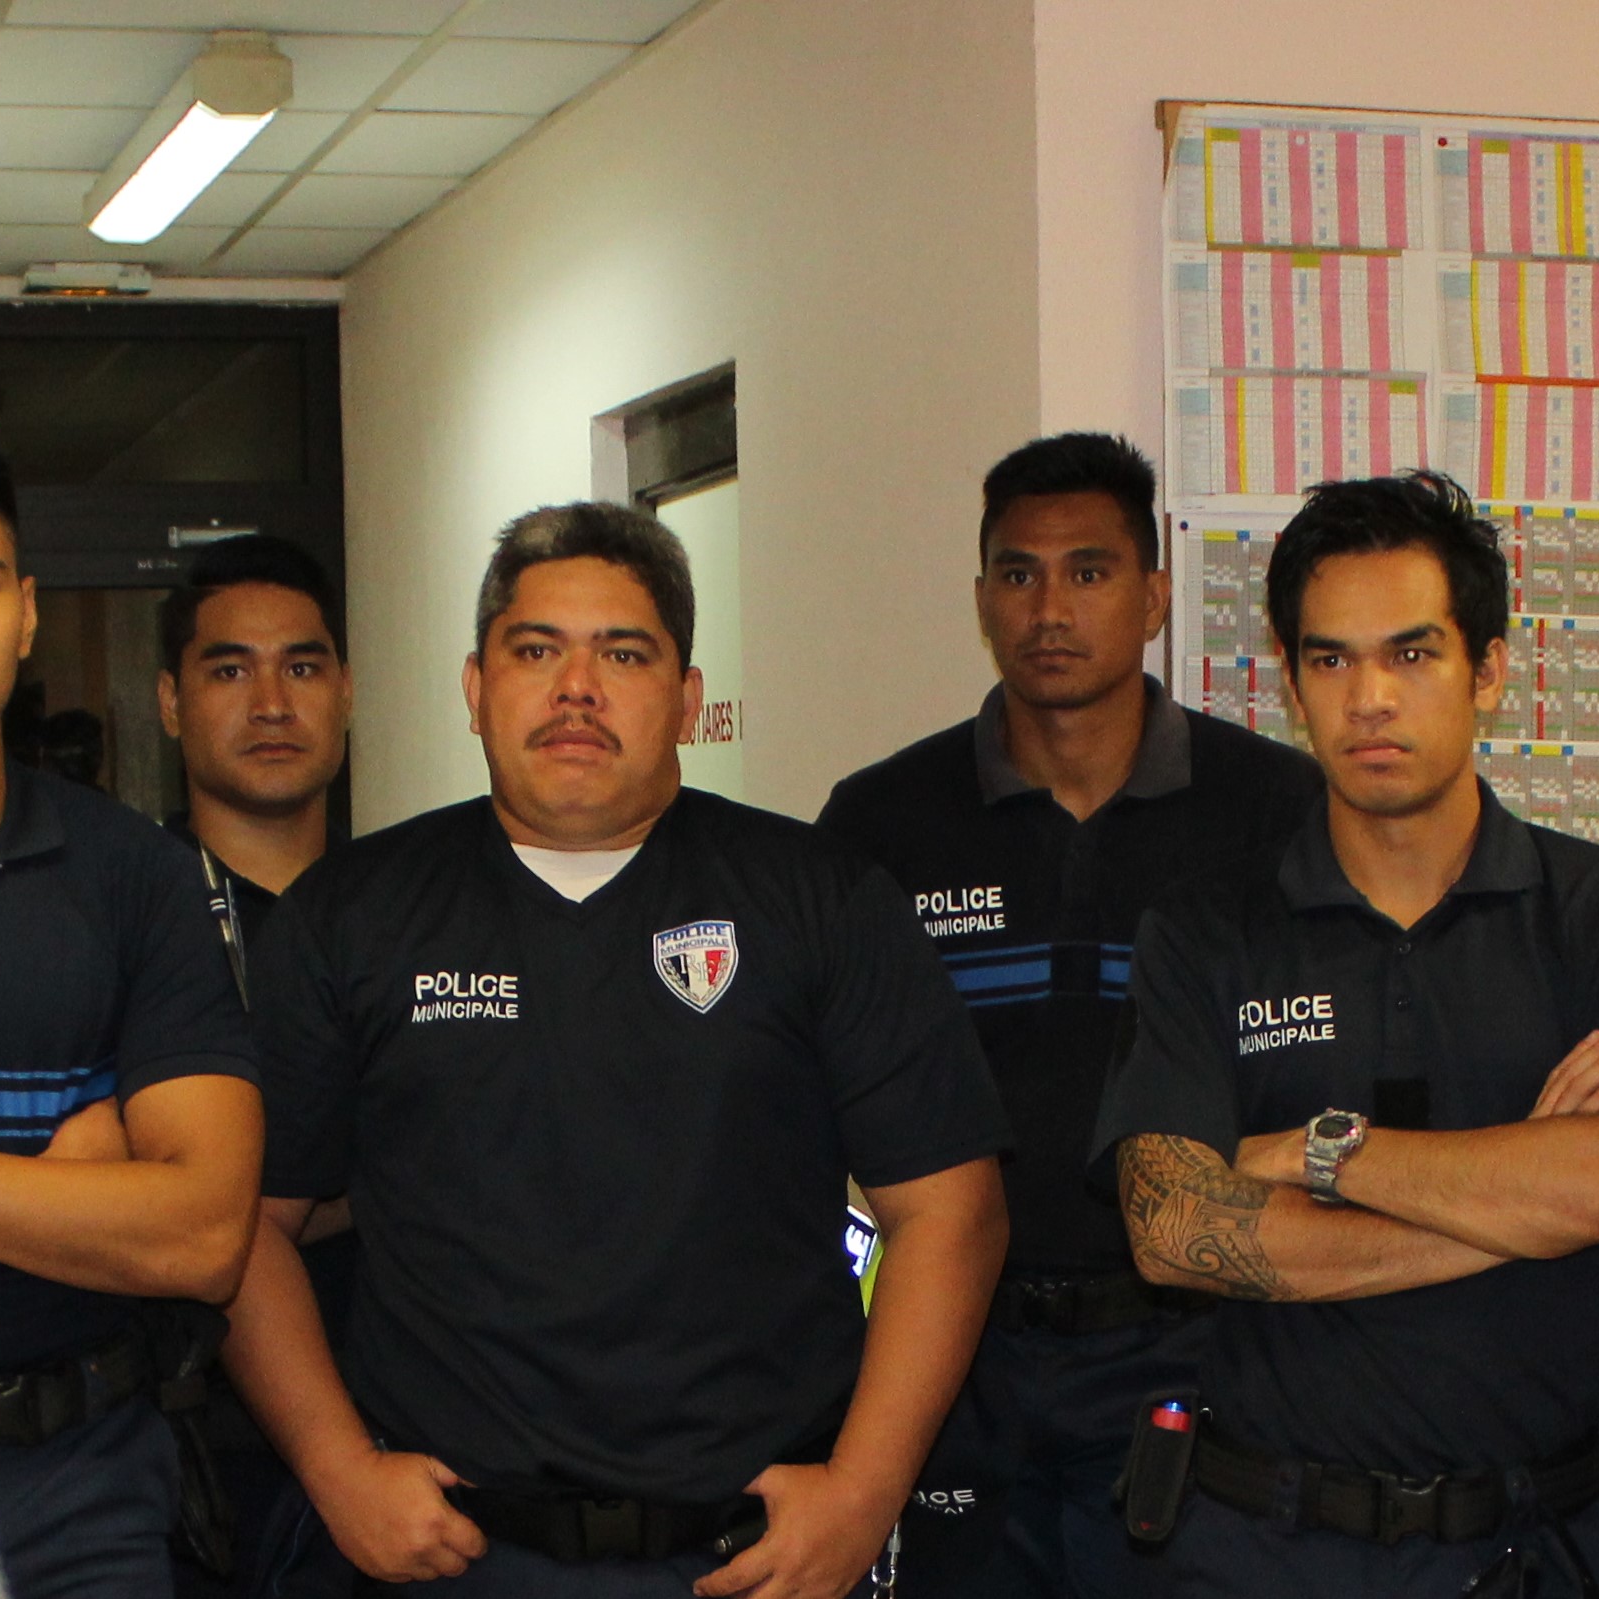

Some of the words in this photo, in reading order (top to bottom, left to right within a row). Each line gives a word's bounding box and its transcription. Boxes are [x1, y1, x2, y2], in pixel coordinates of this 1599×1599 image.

[915, 886, 1004, 916] POLICE
[415, 971, 519, 1001] POLICE
[411, 1000, 519, 1023] MUNICIPALE
